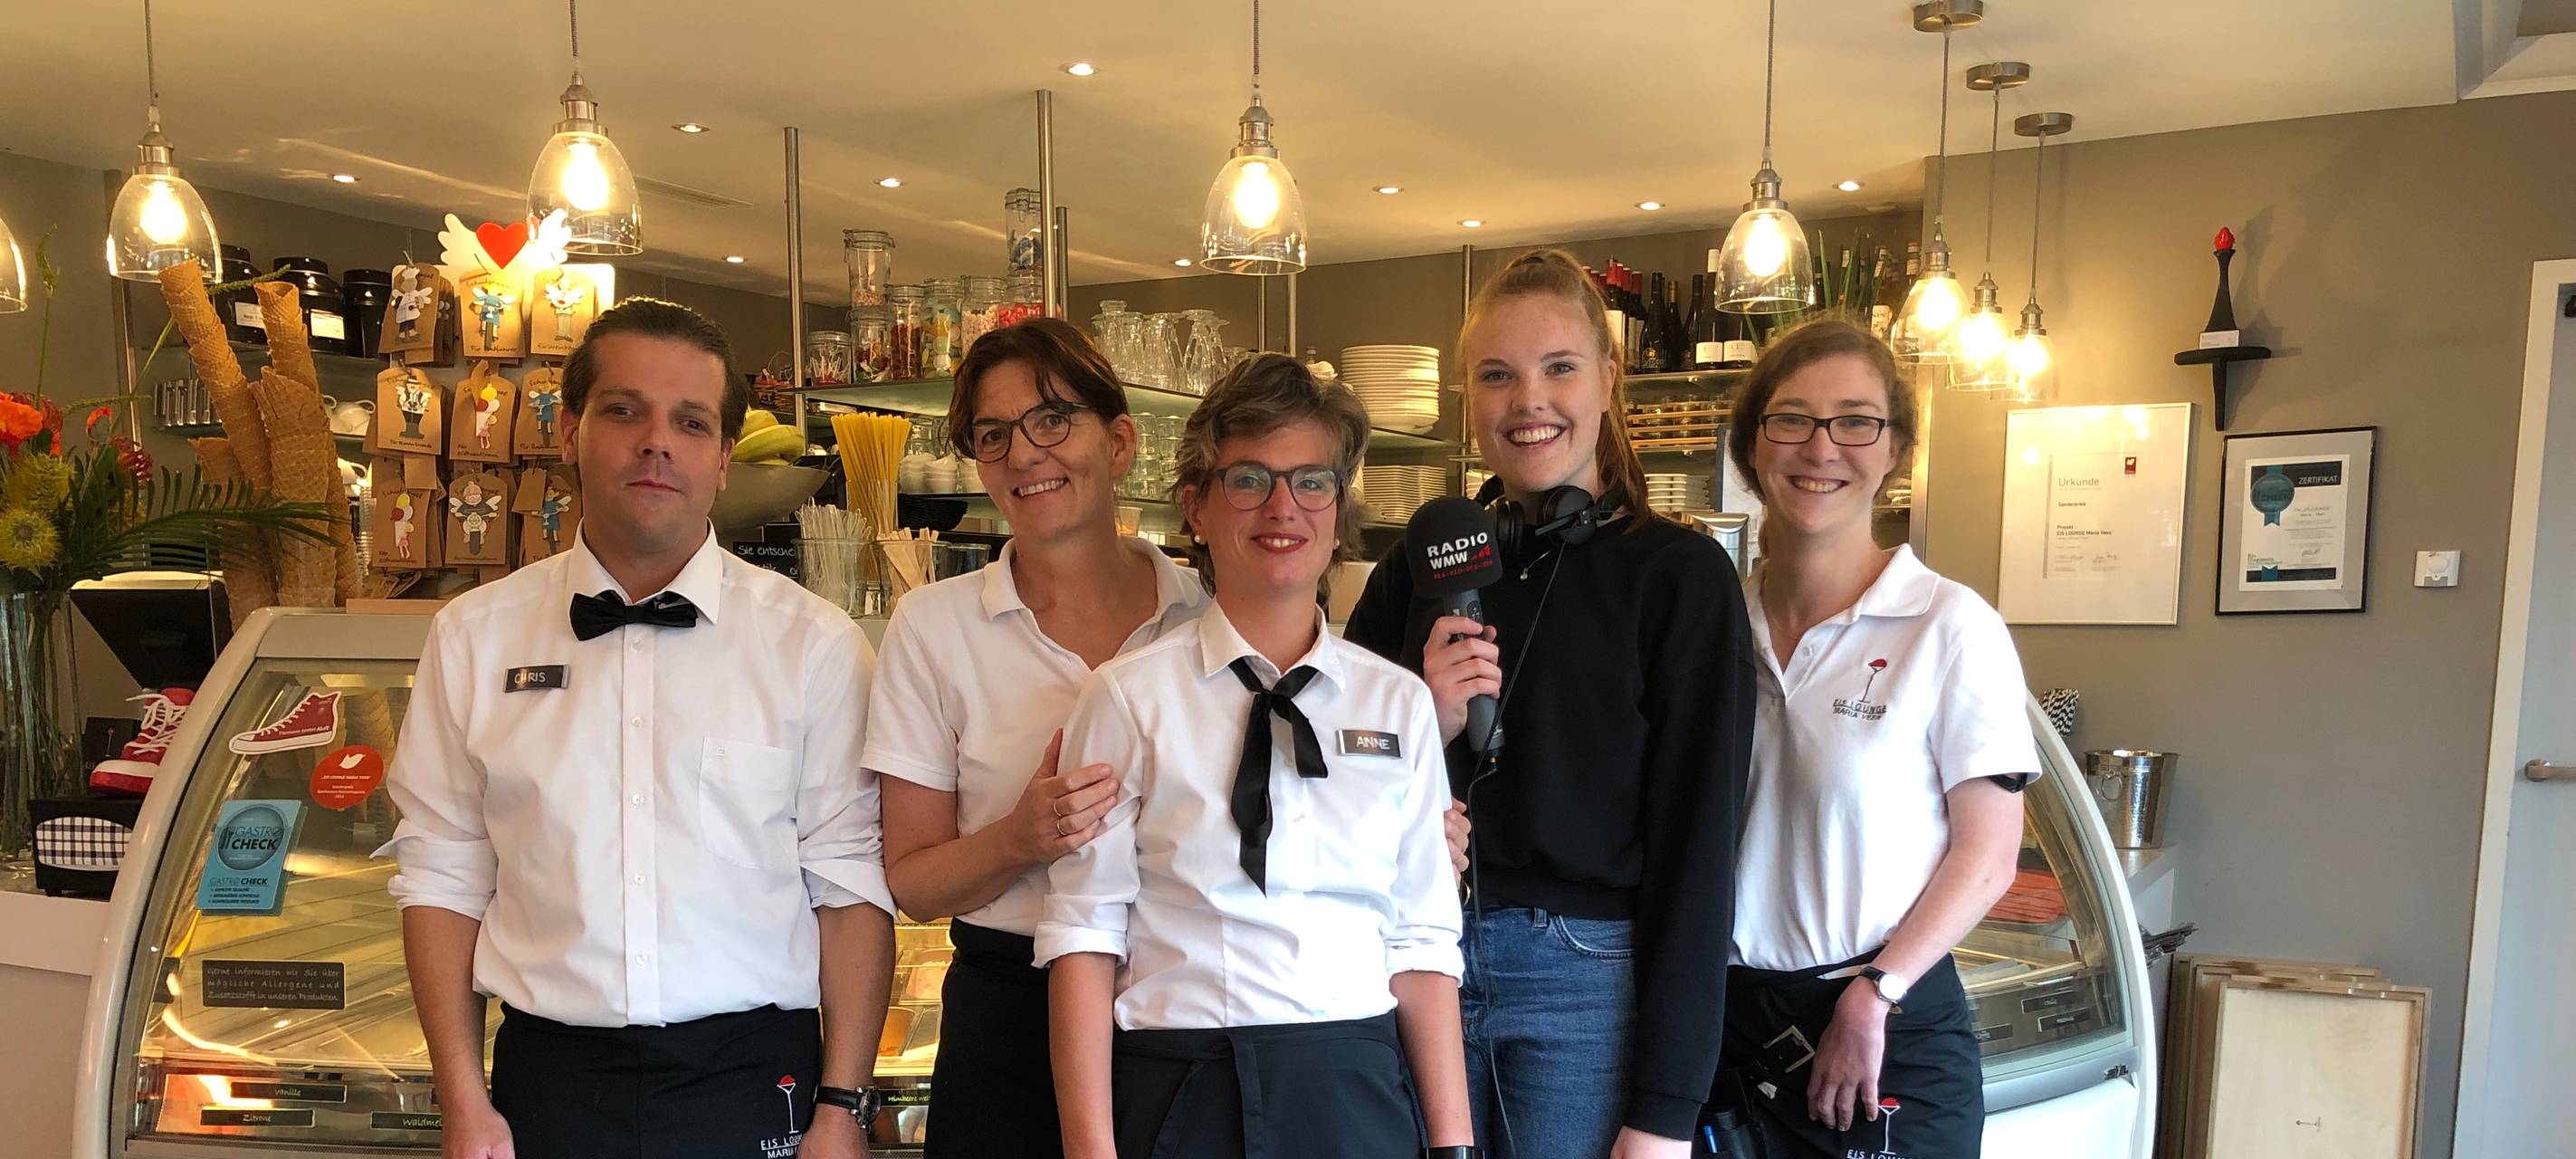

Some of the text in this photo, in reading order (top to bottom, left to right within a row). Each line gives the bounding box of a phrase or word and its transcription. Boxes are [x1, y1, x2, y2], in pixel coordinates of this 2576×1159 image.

[2058, 478, 2100, 486] Urkunde
[2298, 475, 2338, 484] ZERTIFIKAT
[1427, 532, 1488, 557] RADIO
[738, 545, 797, 557] Sie entsche
[1430, 551, 1467, 570] WMW
[514, 672, 546, 684] CHRIS
[1850, 701, 1887, 714] LOUNGE
[1356, 736, 1390, 750] ANNE
[231, 838, 278, 849] CHECK
[207, 967, 231, 976] Gerne
[261, 979, 312, 991] Allergene
[320, 980, 339, 989] und
[243, 1114, 272, 1123] Zitrone
[403, 1117, 443, 1127] Waldmei
[760, 1138, 778, 1150] EIS
